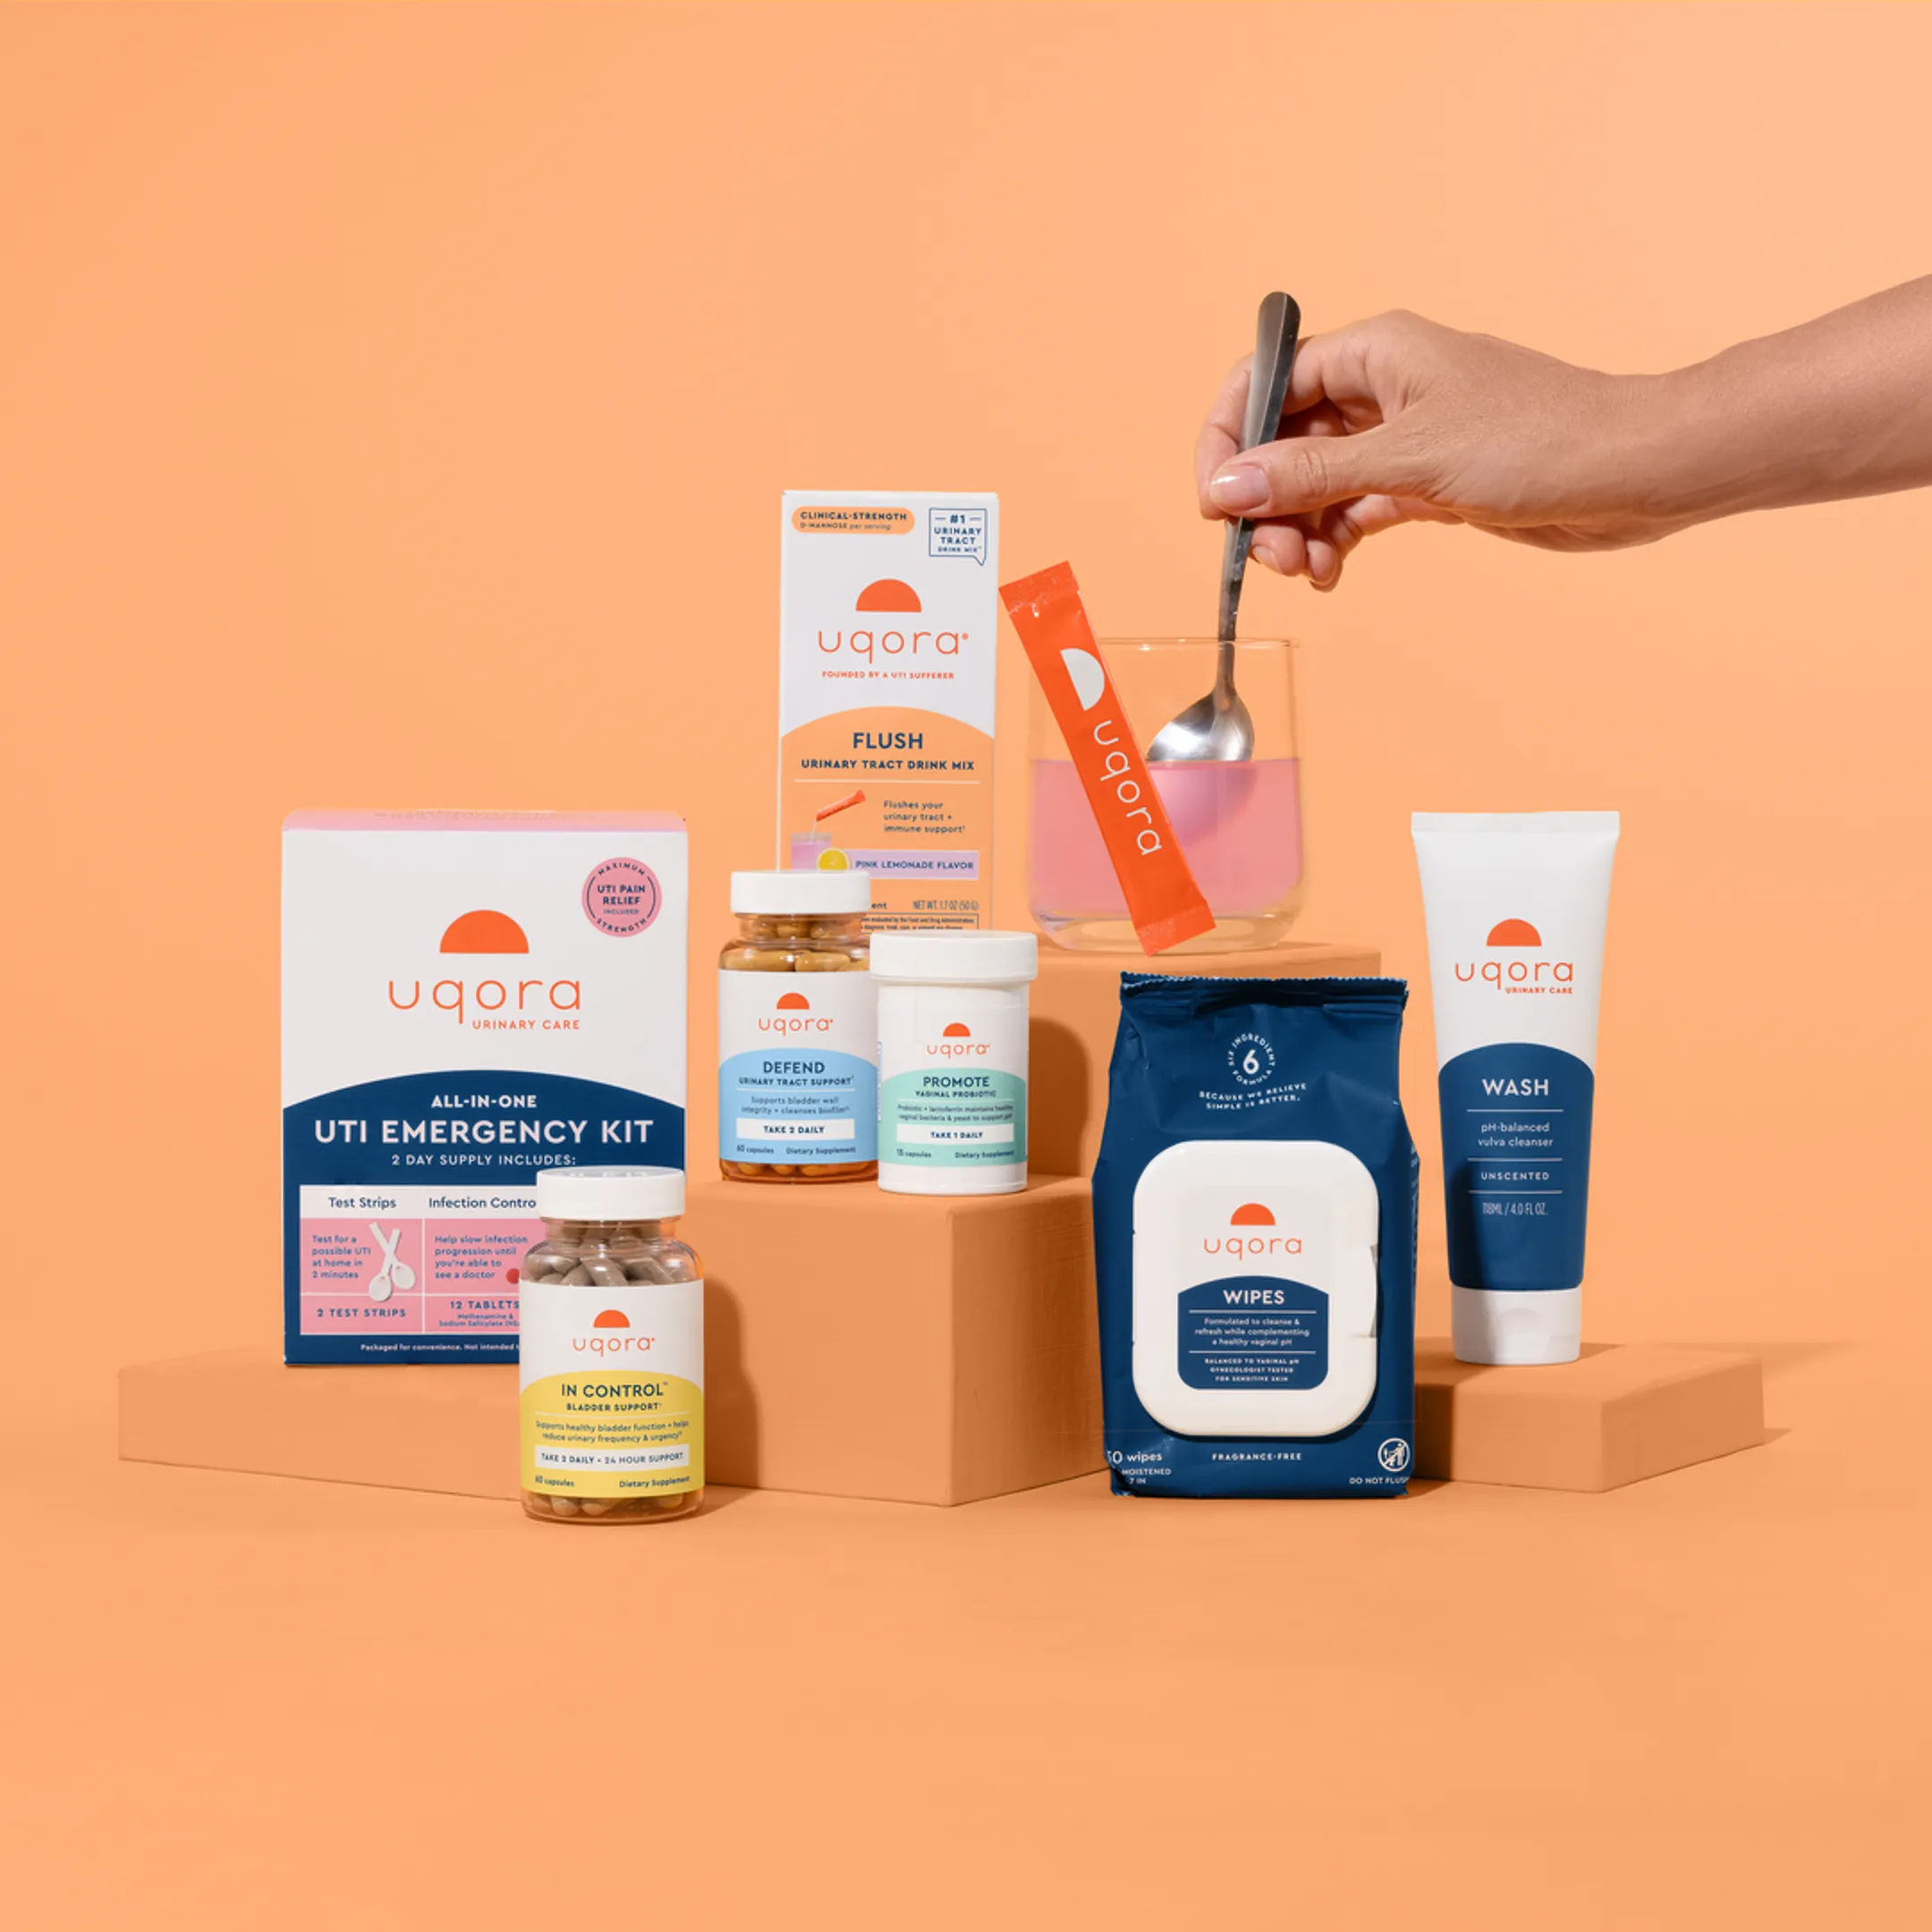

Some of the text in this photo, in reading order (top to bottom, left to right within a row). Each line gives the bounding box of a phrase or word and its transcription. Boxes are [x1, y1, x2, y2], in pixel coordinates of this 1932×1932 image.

[801, 512, 907, 521] CLINICAL-STRENGTH
[950, 515, 965, 524] #1
[934, 527, 981, 536] URINARY
[940, 537, 976, 545] TRACT
[822, 671, 866, 679] FOUNDED
[910, 672, 954, 680] SUFFERER
[852, 733, 923, 749] FLUSH
[801, 759, 974, 771] URINARY TRACT DRINK MIX
[1093, 720, 1163, 856] uqora
[884, 801, 944, 810] Flushes your
[884, 813, 944, 822] urinary tract
[884, 825, 921, 834] immune
[597, 862, 645, 876] MAXIMUM
[855, 860, 973, 869] PINK LEMONADE FLAVOR
[597, 885, 645, 893] UTI PAIN
[603, 896, 640, 904] RELIEF
[1455, 962, 1573, 990] uqora
[388, 979, 580, 1023] uqora
[472, 1020, 580, 1030] URINARY CARE
[1243, 1048, 1259, 1074] 6
[763, 1061, 826, 1074] DEFEND
[739, 1077, 774, 1085] URINARY
[923, 1077, 990, 1088] PROMOTE
[1199, 1091, 1242, 1101] BECAUSE
[1267, 1082, 1307, 1095] BELIEVE
[1481, 1079, 1549, 1096] WASH
[431, 1095, 537, 1108] ALL-IN-ONE
[315, 1119, 654, 1144] UTI EMERGENCY KIT
[763, 1125, 786, 1133] TAKE
[798, 1125, 825, 1134] DAILY
[1481, 1123, 1549, 1133] pH-balanced
[1478, 1137, 1553, 1148] vulva cleanser
[747, 1147, 774, 1155] capsules
[392, 1155, 576, 1165] 2 DAY SUPPLY INCLUDES:
[1481, 1172, 1550, 1181] UNSCENTED
[328, 1196, 397, 1210] Test Strips
[429, 1196, 537, 1208] Infection Contro
[312, 1234, 332, 1243] Test
[335, 1234, 348, 1243] for
[435, 1234, 528, 1244] Help slow infection
[312, 1247, 371, 1257] possible UTI
[435, 1247, 516, 1257] progression until
[1204, 1238, 1302, 1261] uqora
[312, 1258, 363, 1267] at home in
[468, 1259, 488, 1267] able
[312, 1270, 359, 1278] 2 minutes
[462, 1270, 495, 1278] doctor
[1223, 1290, 1284, 1305] WIPES
[450, 1301, 520, 1309] 12 TABLETS
[317, 1309, 406, 1318] 2 TEST STRIPS
[1195, 1327, 1223, 1335] refresh
[1248, 1328, 1309, 1337] complementing
[561, 1384, 577, 1396] IN
[566, 1402, 611, 1411] BLADDER
[597, 1424, 631, 1432] bladder
[633, 1422, 665, 1431] function
[568, 1435, 596, 1444] urinary
[597, 1435, 640, 1444] frequency
[541, 1453, 559, 1462] TAKE
[605, 1456, 616, 1464] 24
[619, 1455, 646, 1463] HOUR
[648, 1453, 683, 1462] SUPPORT
[1127, 1451, 1163, 1463] wipes
[1212, 1453, 1302, 1462] FRAGRANCE-FREE
[619, 1479, 649, 1488] Dietary
